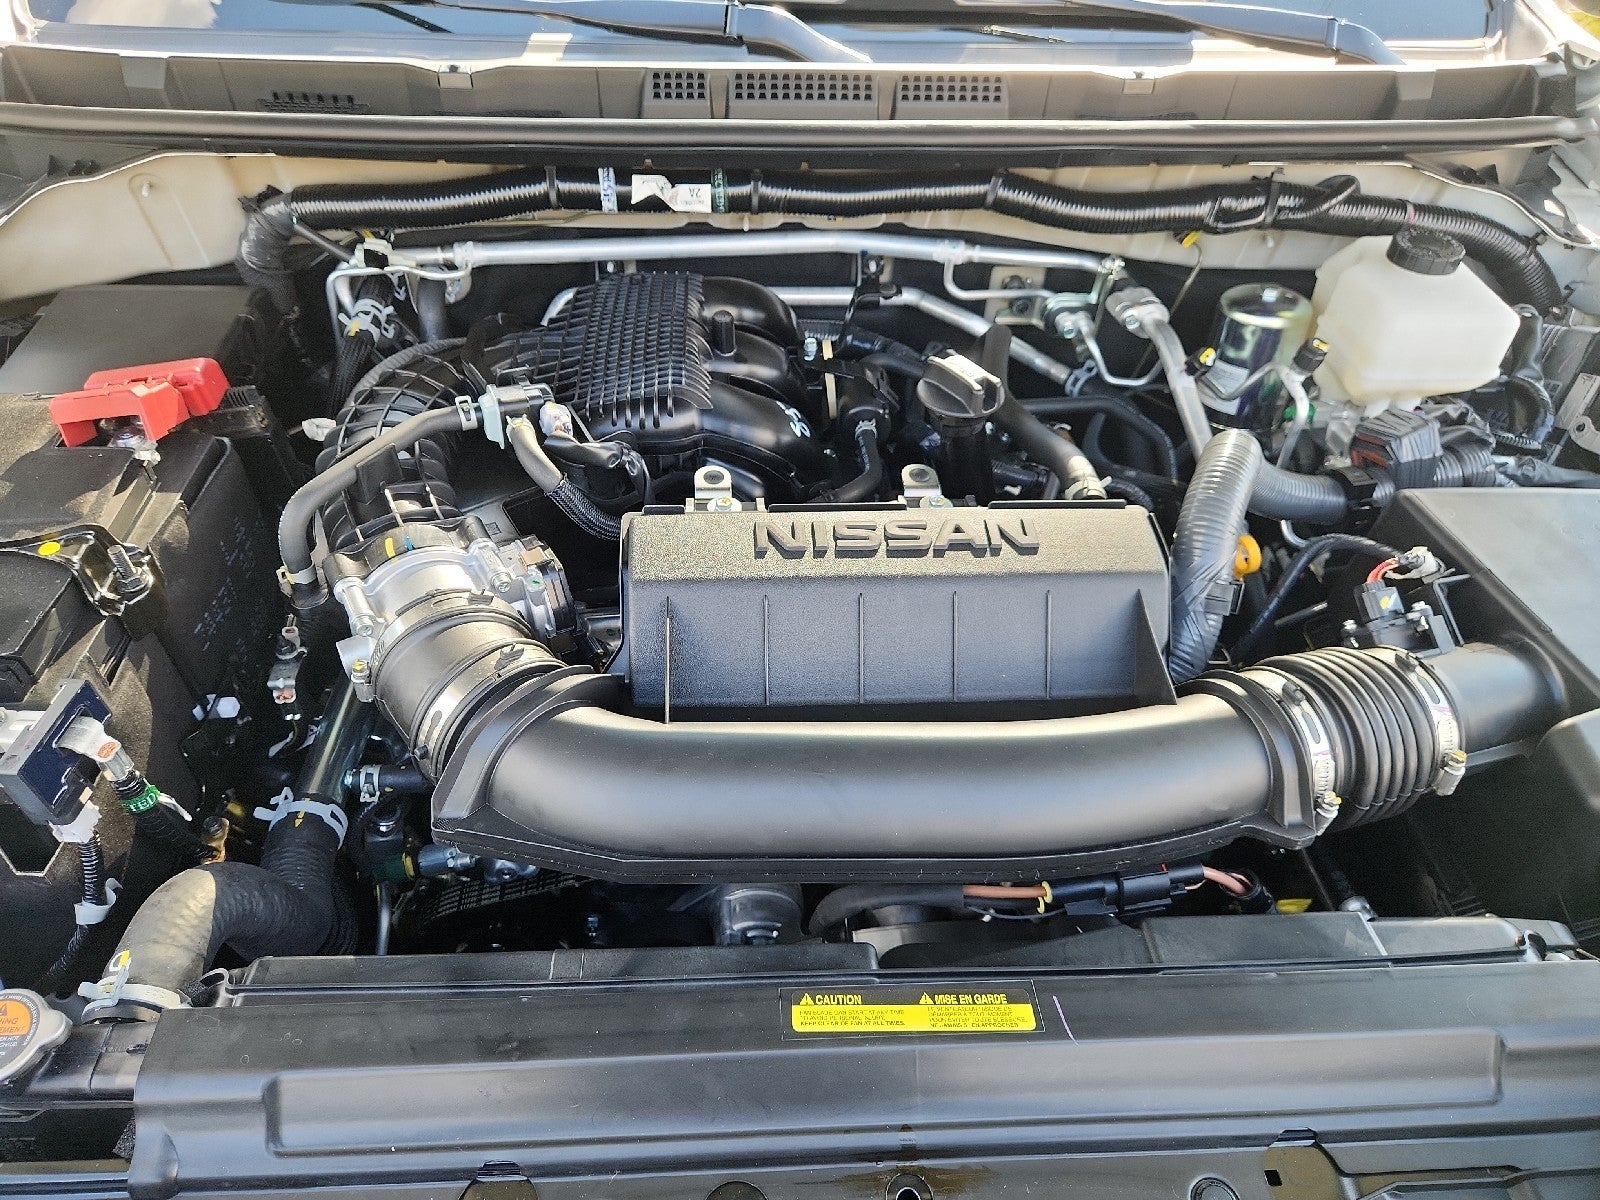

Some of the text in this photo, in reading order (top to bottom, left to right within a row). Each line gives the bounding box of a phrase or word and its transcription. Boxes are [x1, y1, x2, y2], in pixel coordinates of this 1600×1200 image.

[754, 519, 1040, 557] NISSAN
[815, 994, 862, 1005] CAUTION
[934, 993, 1008, 1005] MISE EN GARDE
